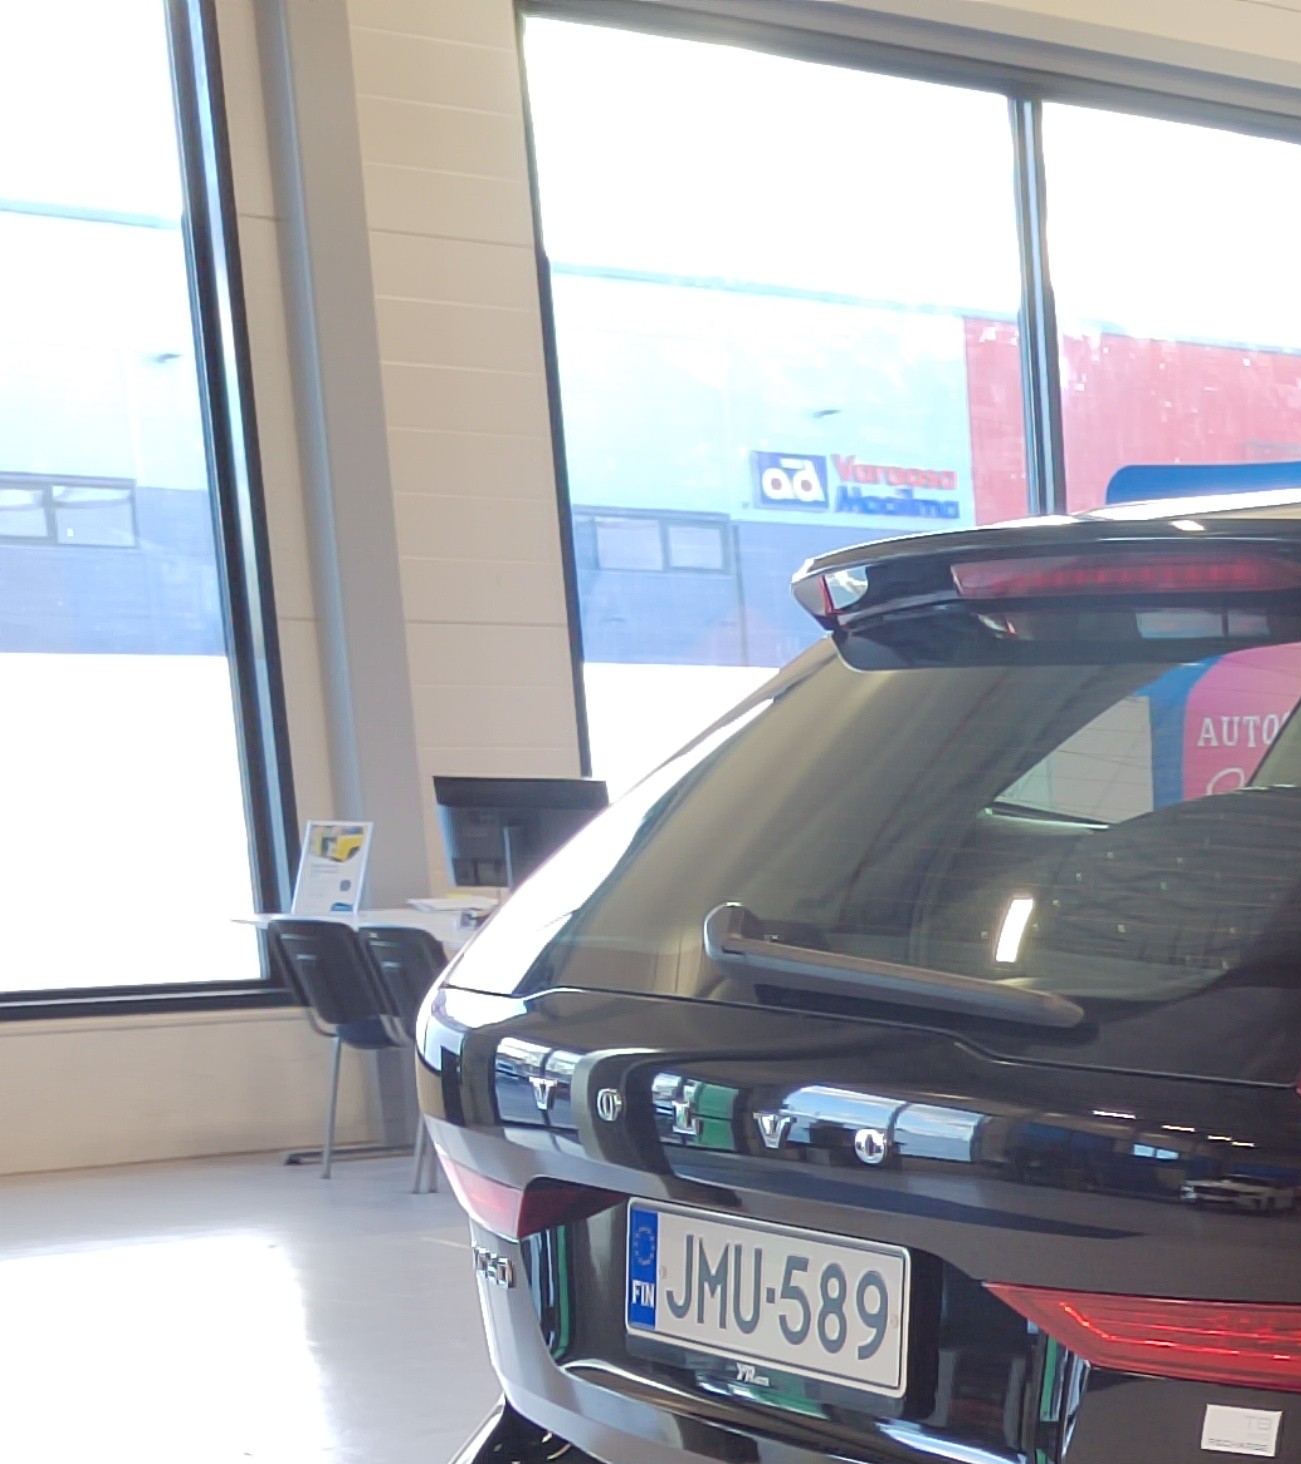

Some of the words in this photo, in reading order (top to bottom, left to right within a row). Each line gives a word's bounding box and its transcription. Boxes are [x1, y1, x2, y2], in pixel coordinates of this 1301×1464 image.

[528, 1075, 889, 1166] VOLVO
[631, 1279, 655, 1308] FIN
[665, 1232, 890, 1361] JMU-589
